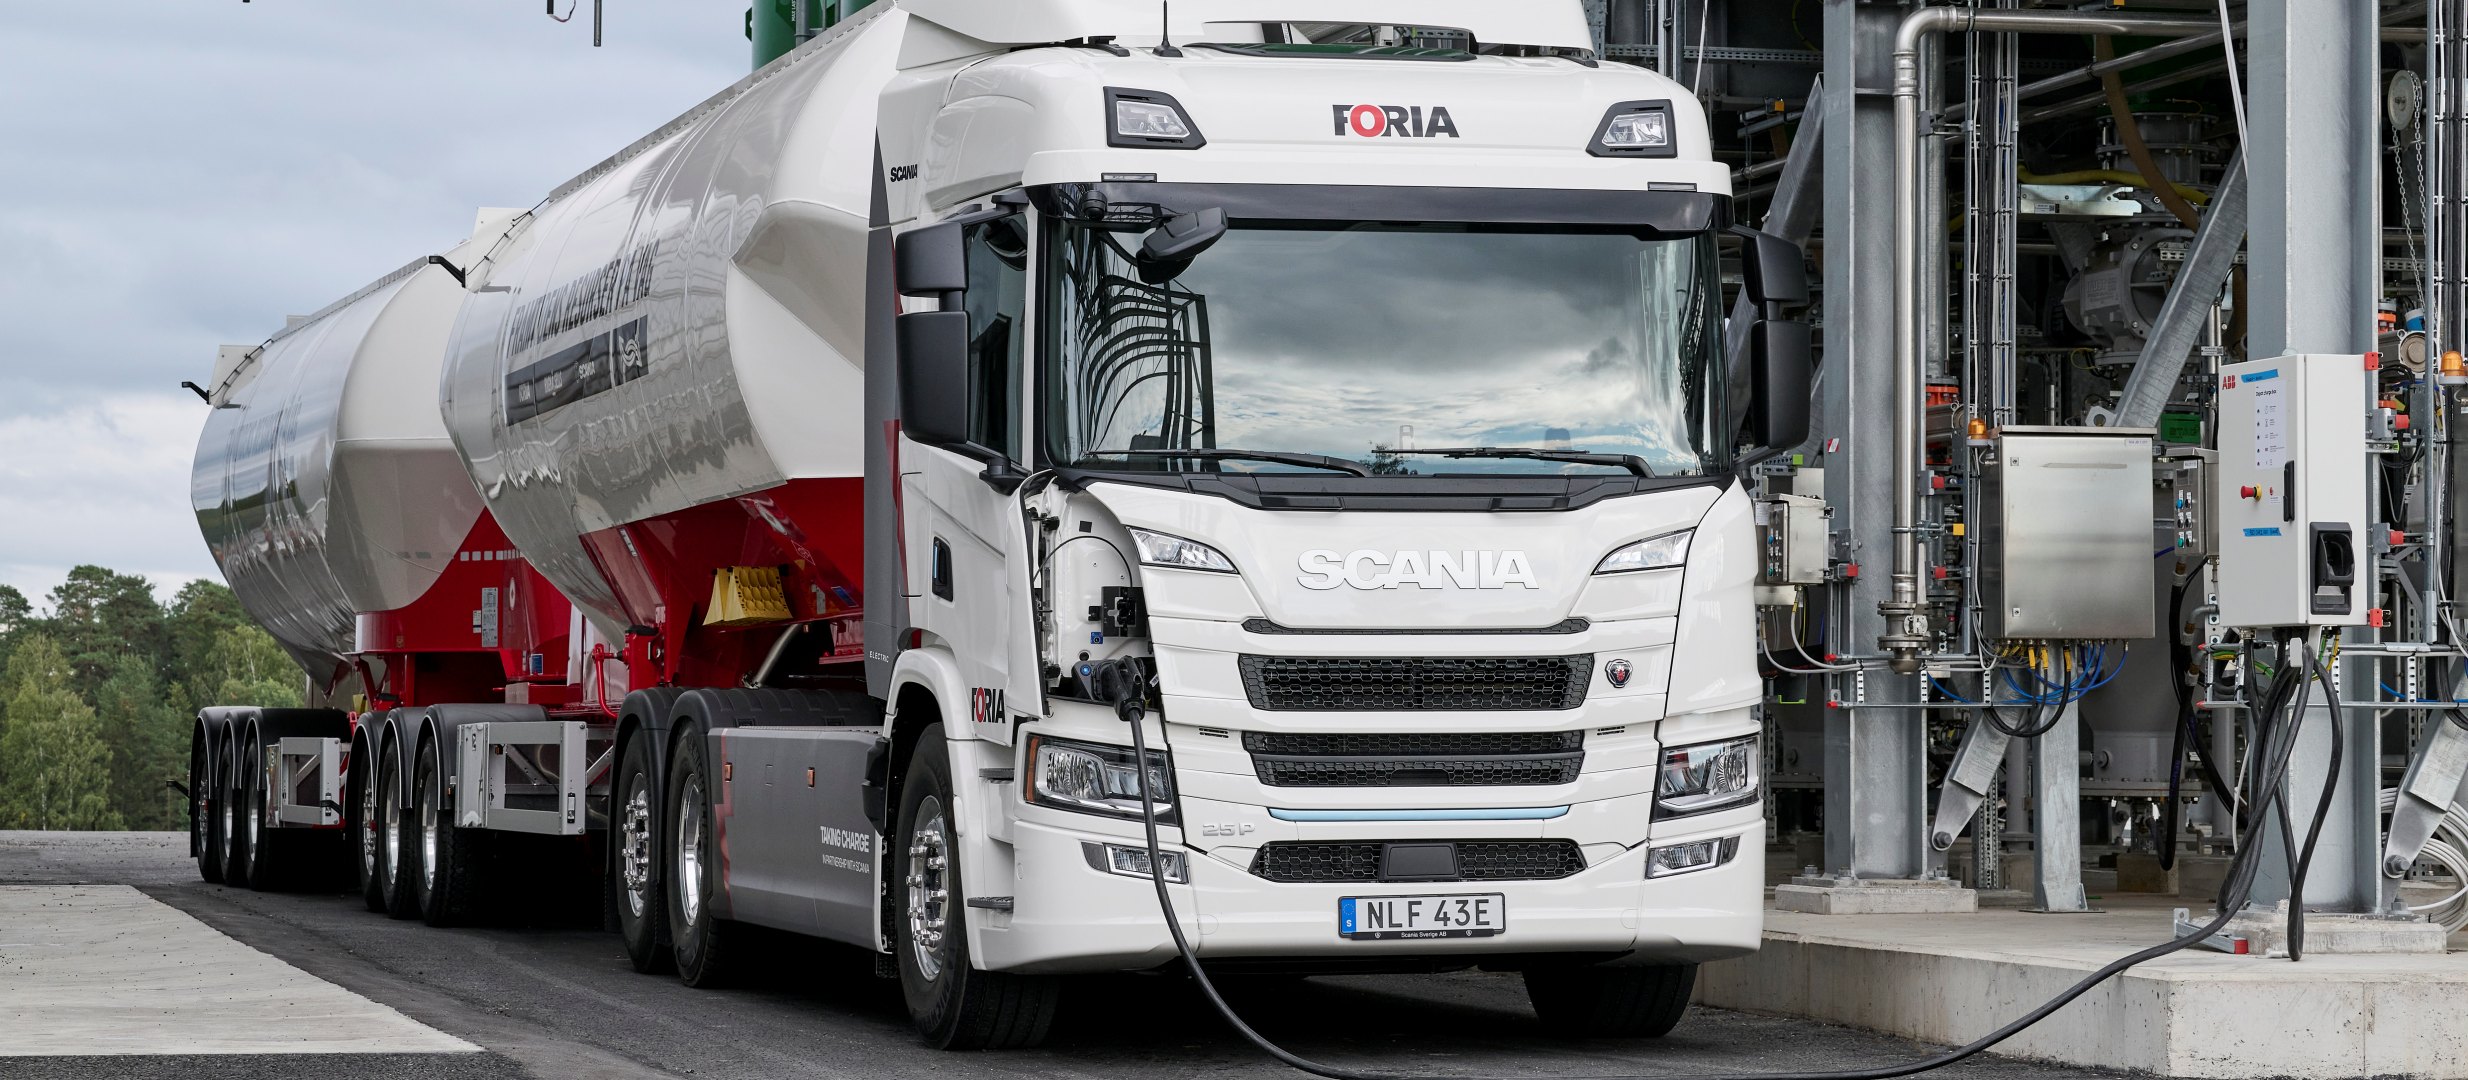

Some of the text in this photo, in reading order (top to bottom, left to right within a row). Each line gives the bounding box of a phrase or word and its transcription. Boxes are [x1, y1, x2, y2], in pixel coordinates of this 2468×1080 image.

[1332, 104, 1460, 138] FORIA
[890, 164, 918, 182] SCANIA
[2222, 375, 2236, 390] ABB
[1296, 550, 1539, 590] SCANIA
[869, 651, 889, 663] ELECTRIC
[971, 687, 1006, 723] FORIA
[820, 826, 869, 852] TAKING CHARGE
[1346, 919, 1352, 927] S
[1367, 899, 1490, 929] NLF 43E
